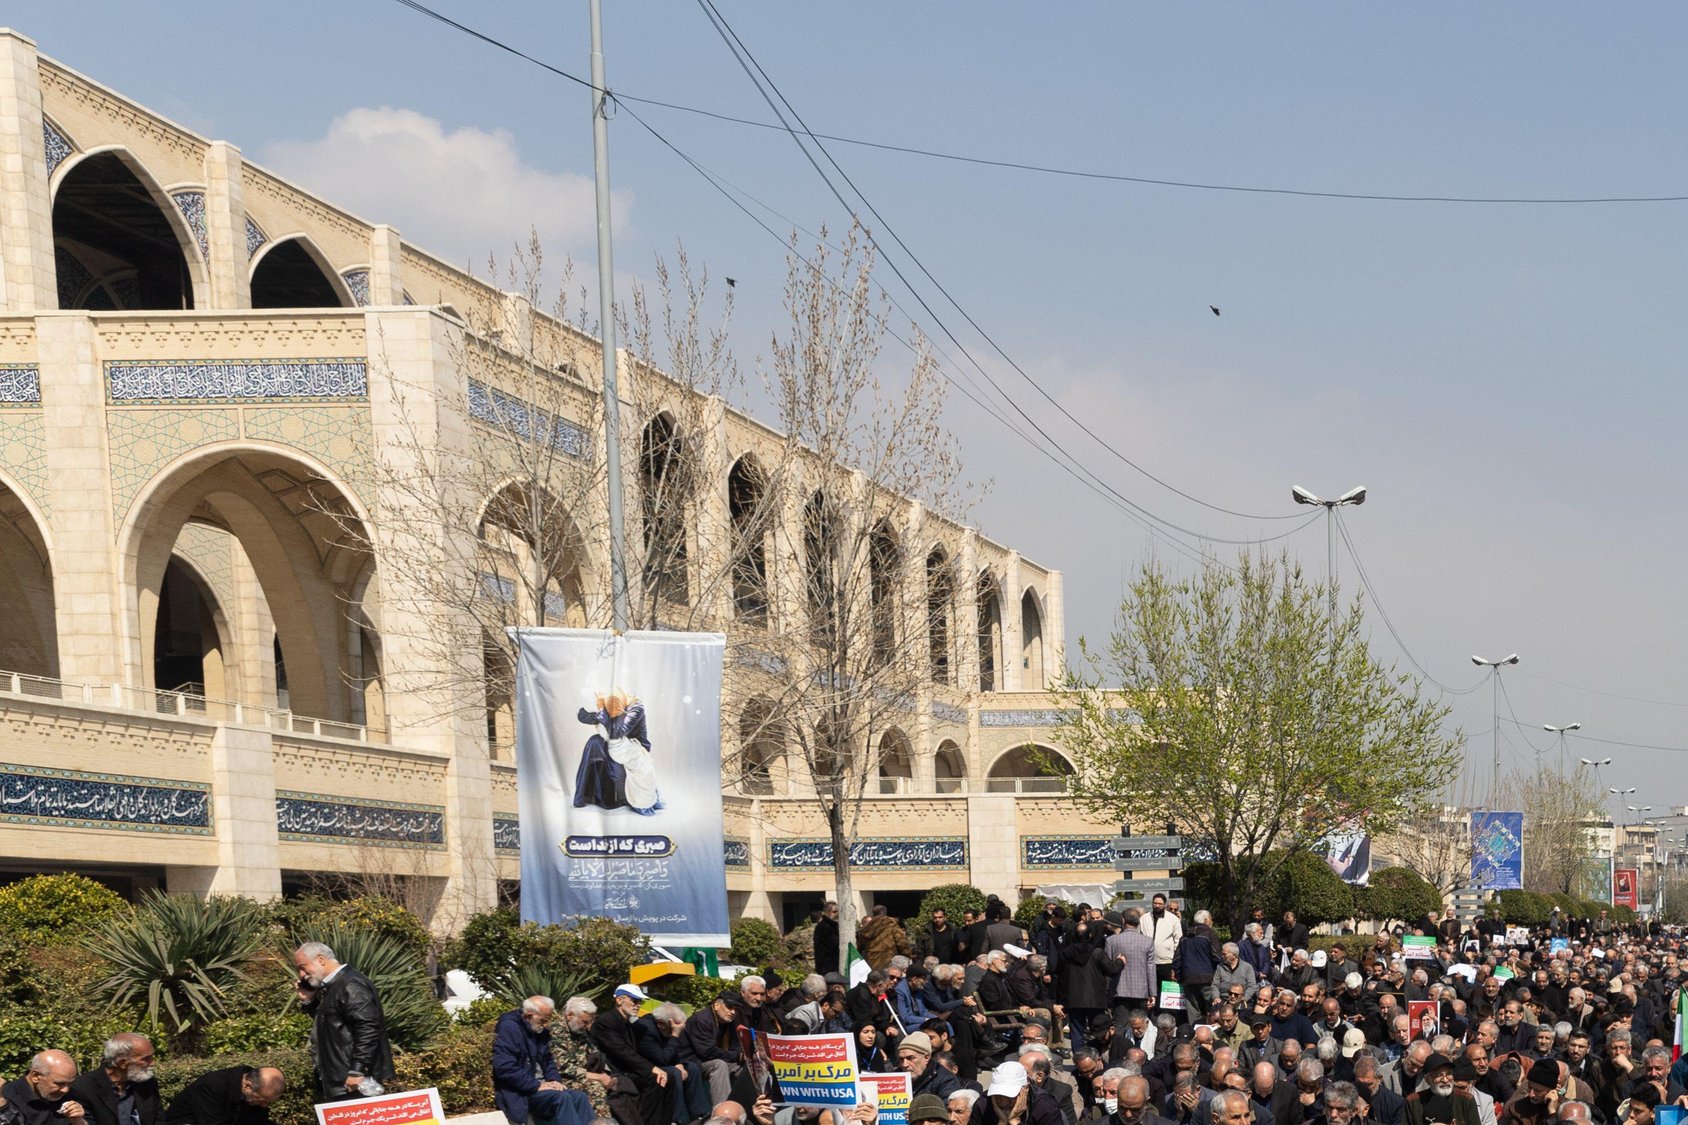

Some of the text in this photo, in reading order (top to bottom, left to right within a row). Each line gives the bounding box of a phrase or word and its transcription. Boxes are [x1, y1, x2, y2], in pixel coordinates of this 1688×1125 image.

[608, 838, 618, 854] از
[619, 838, 634, 850] که
[635, 840, 665, 854] صبری
[776, 1063, 852, 1080] مرگ بر آمری
[780, 1086, 855, 1099] WN WITH USA
[886, 1096, 909, 1107] مرگ
[879, 1112, 893, 1121] ITH
